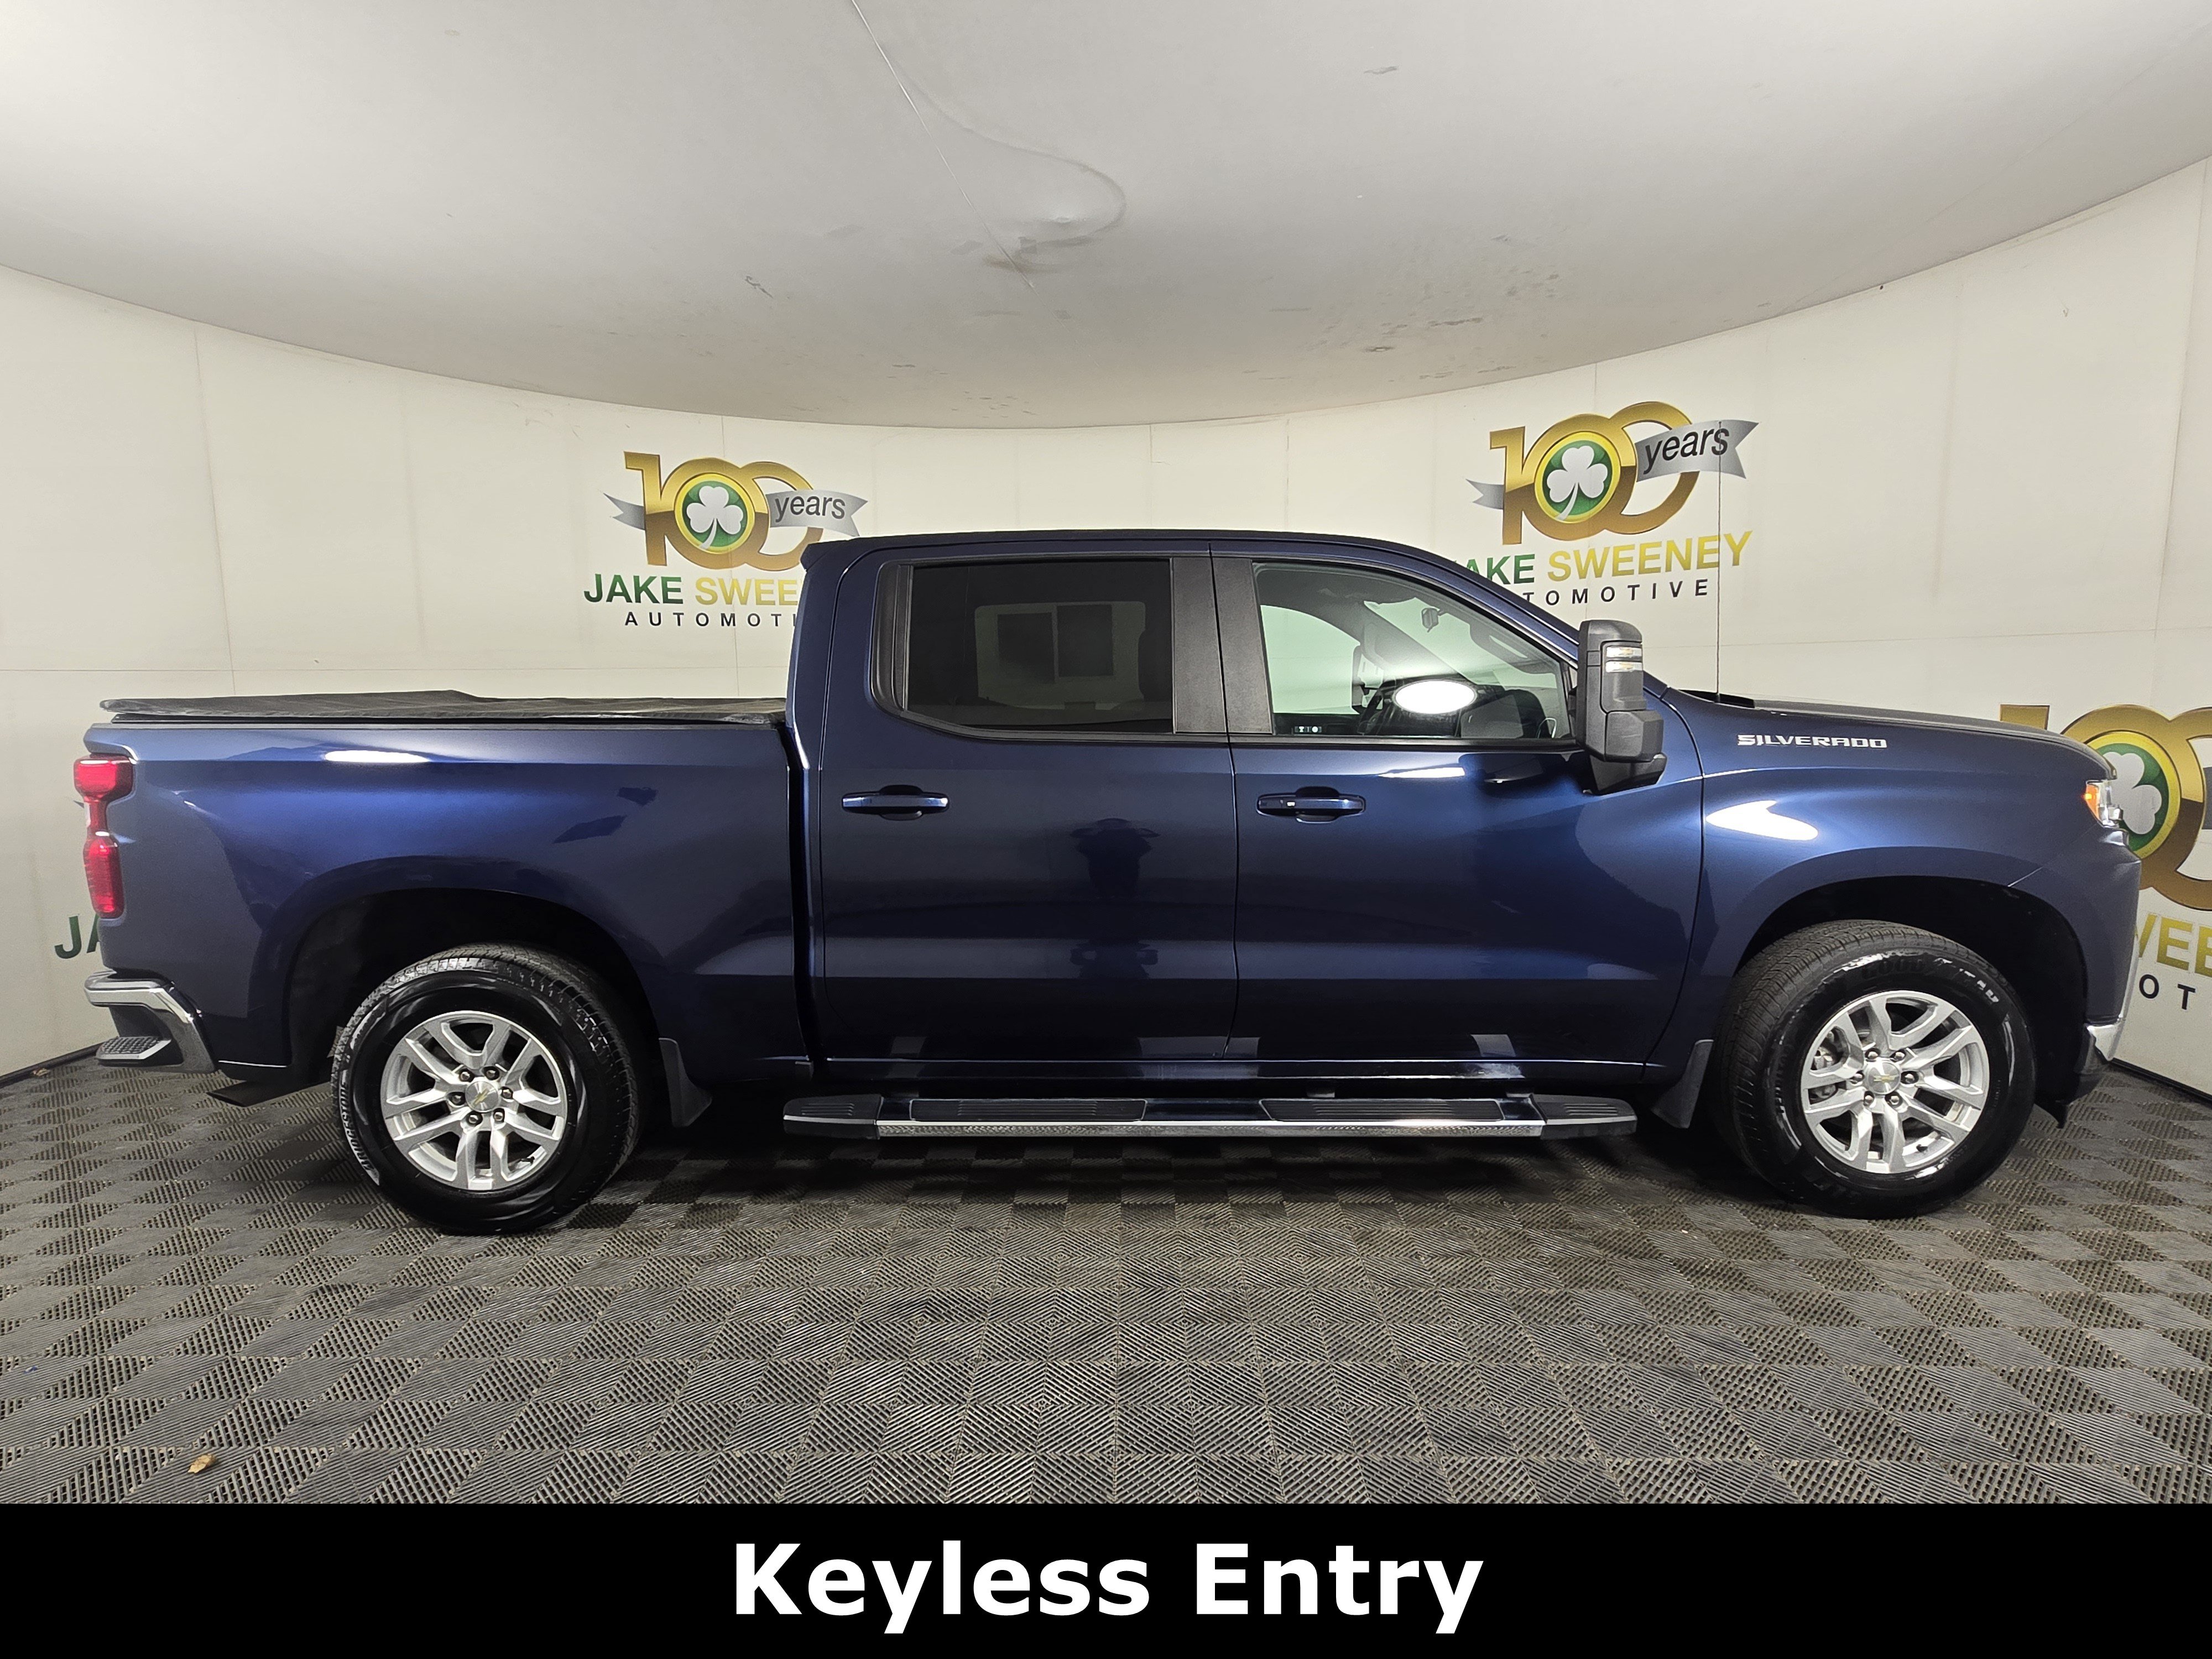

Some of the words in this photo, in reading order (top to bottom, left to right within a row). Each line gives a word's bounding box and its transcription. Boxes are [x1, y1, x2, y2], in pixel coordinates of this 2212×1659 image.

[1643, 425, 1729, 474] years
[774, 494, 846, 522] years
[1547, 530, 1753, 582] SWEENEY
[583, 573, 684, 604] JAKE
[695, 577, 798, 606] SWEE
[1522, 578, 1708, 606] TOMOTIVE
[624, 611, 796, 627] AUTOMOTI
[1737, 734, 1887, 748] SILVERADO
